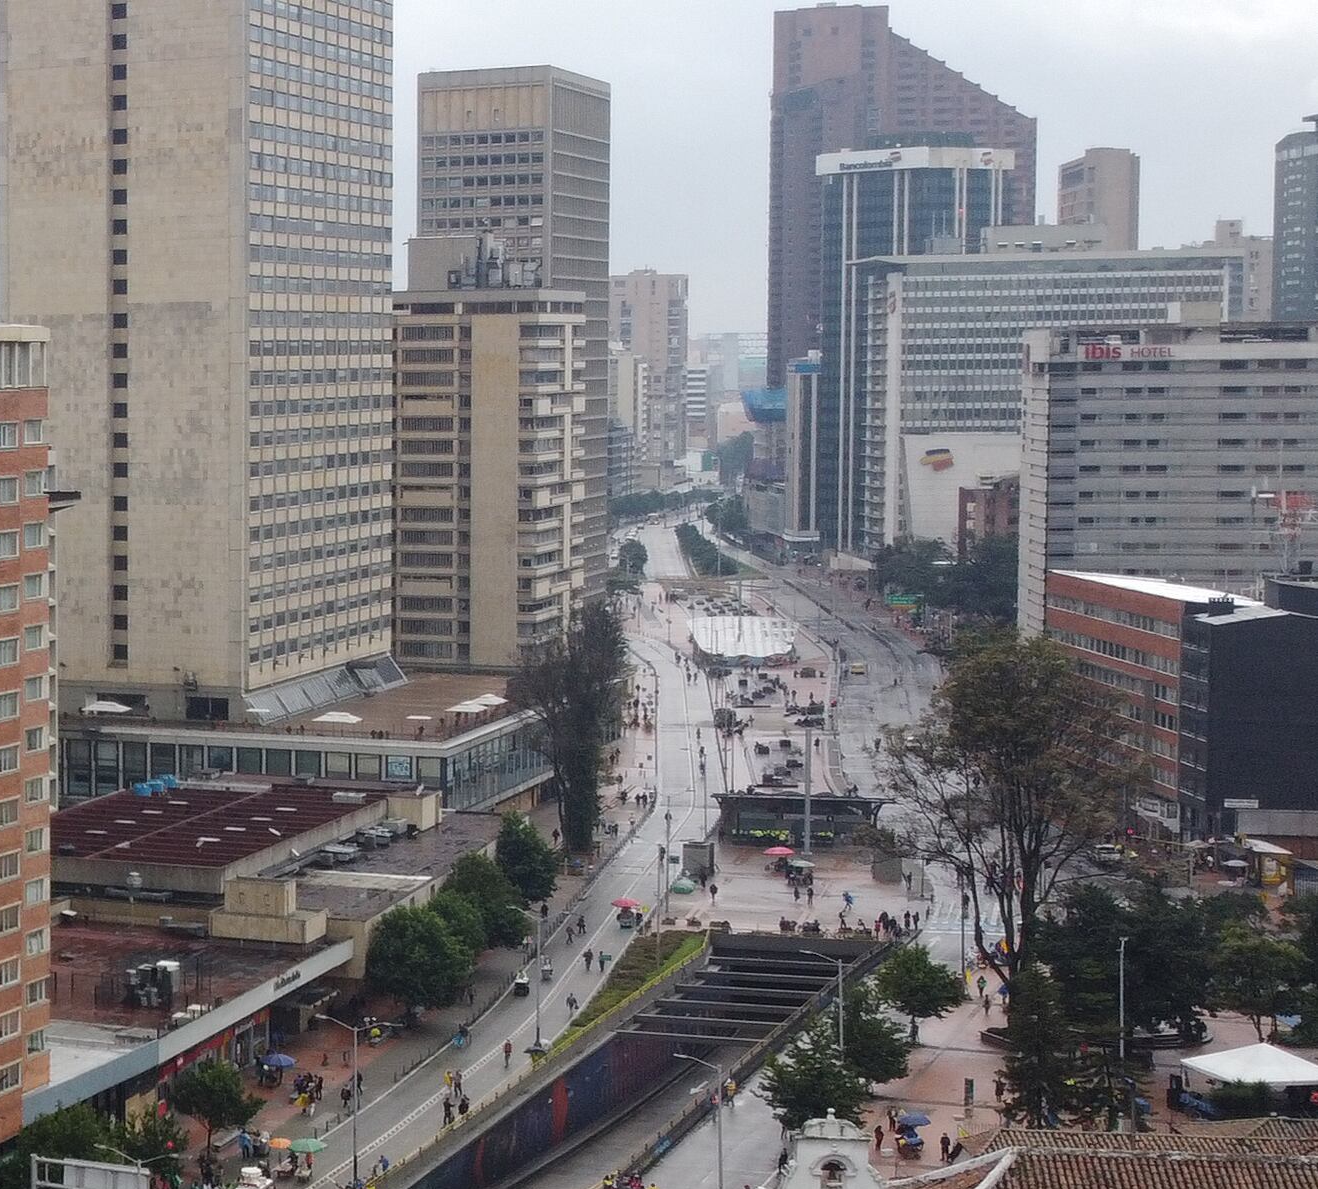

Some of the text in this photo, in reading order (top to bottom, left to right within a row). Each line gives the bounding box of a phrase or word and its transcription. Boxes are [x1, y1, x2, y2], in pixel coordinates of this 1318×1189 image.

[839, 159, 893, 171] Bancolombia
[1085, 343, 1175, 360] ibis HOTEL
